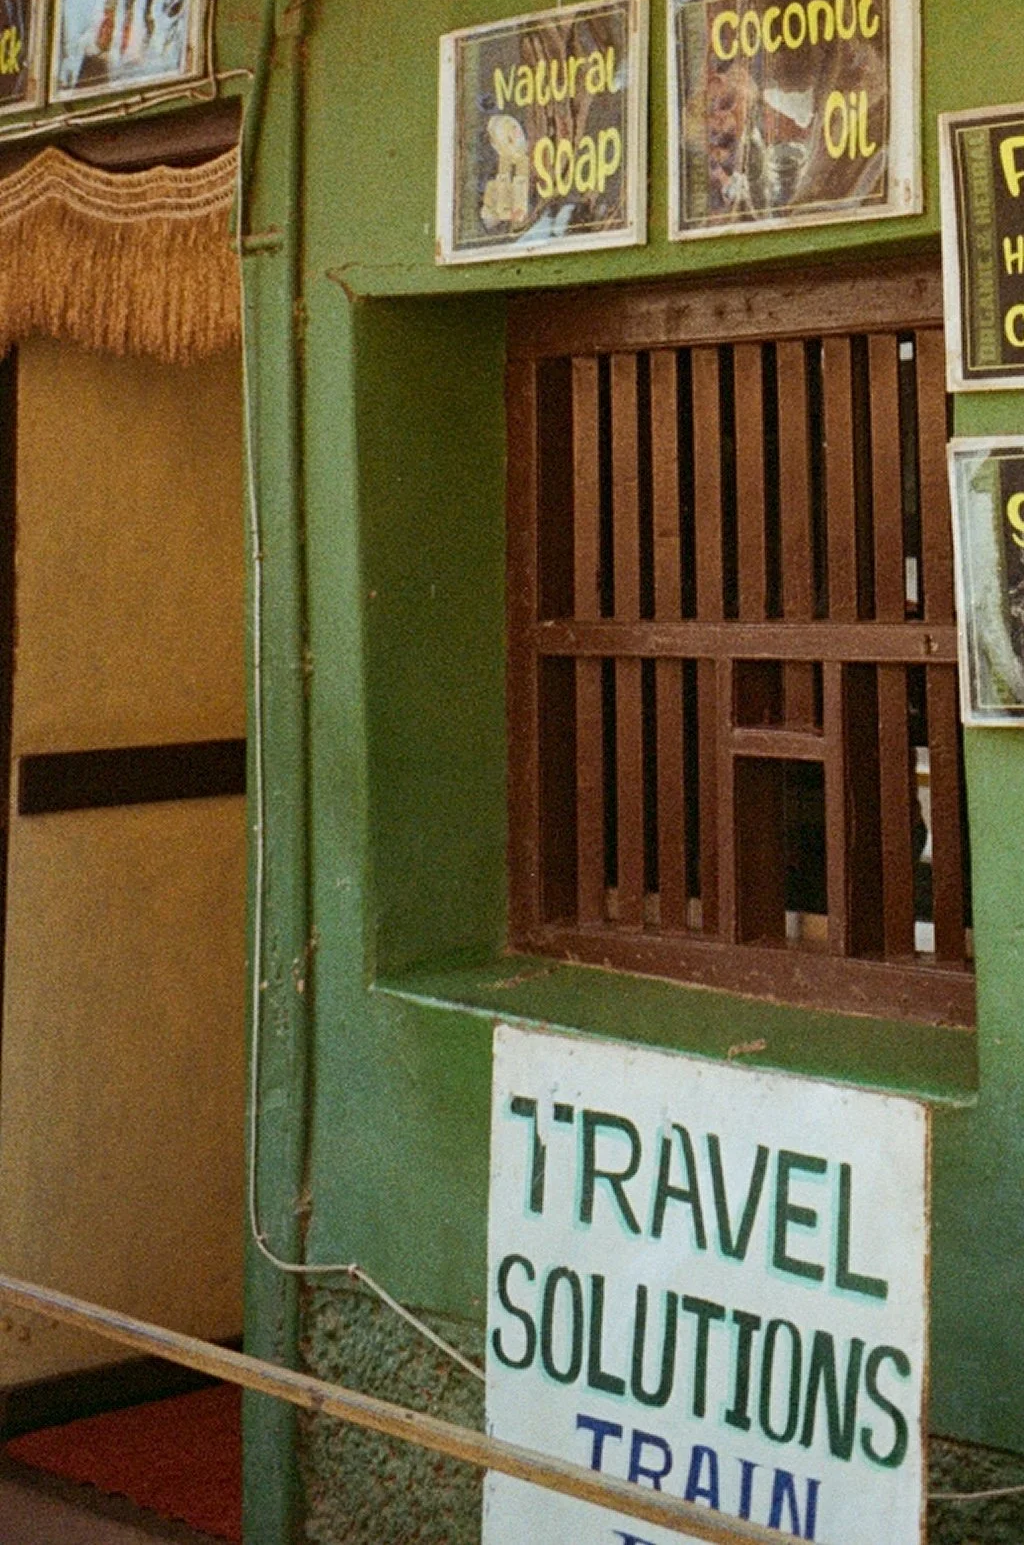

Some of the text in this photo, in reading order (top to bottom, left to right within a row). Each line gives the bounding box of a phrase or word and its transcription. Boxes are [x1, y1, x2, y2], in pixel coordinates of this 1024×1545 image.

[494, 45, 620, 111] Natural
[824, 91, 876, 160] Oil
[508, 1094, 889, 1302] TRAVEL
[491, 1252, 912, 1471] SOLUTIONS
[575, 1412, 822, 1543] TRAIN
